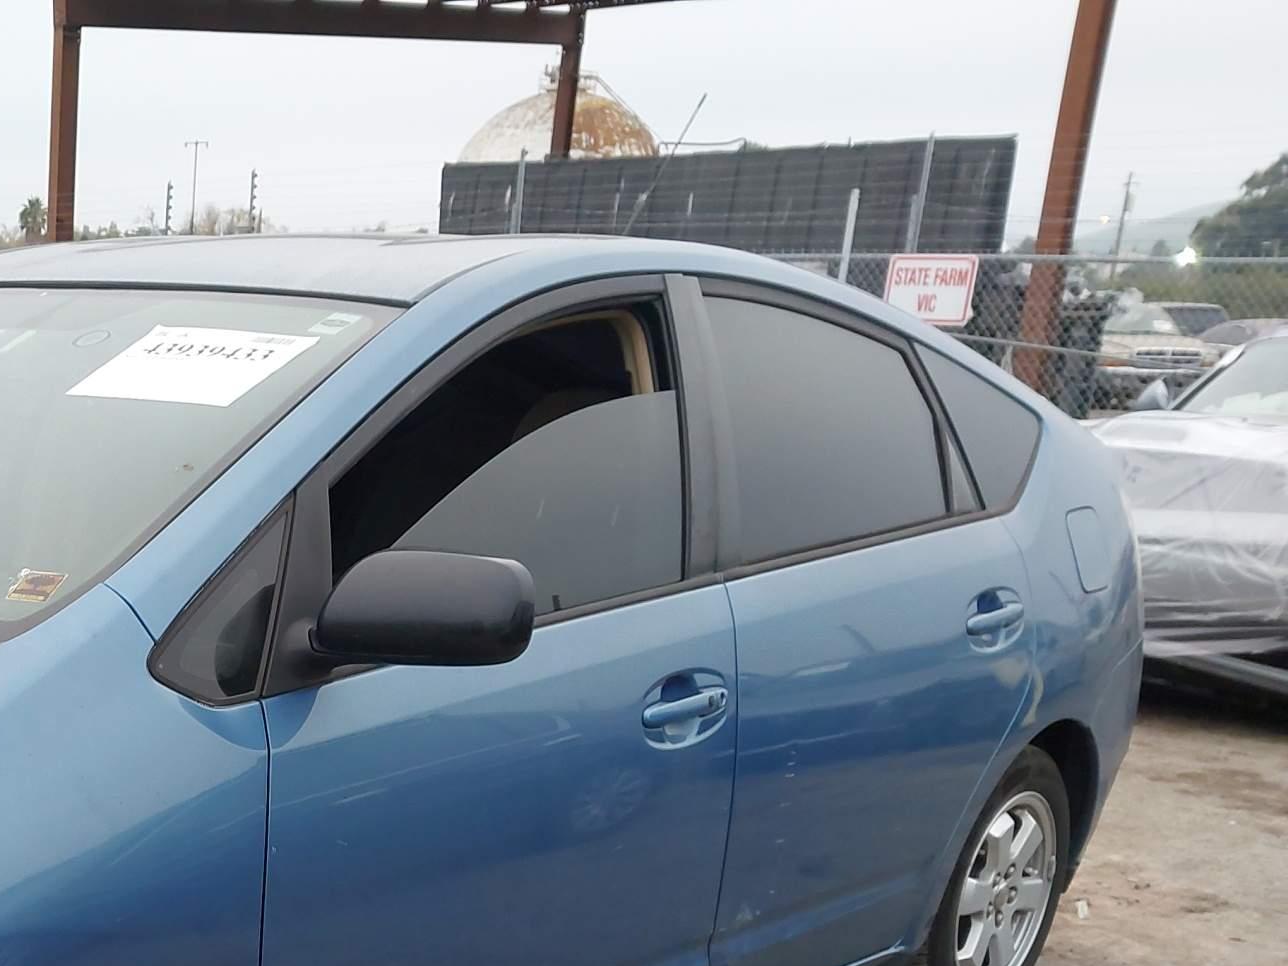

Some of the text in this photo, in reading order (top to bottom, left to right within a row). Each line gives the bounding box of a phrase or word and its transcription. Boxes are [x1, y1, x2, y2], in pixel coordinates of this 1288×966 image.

[894, 267, 969, 286] STATE FARM
[916, 293, 937, 313] VIC
